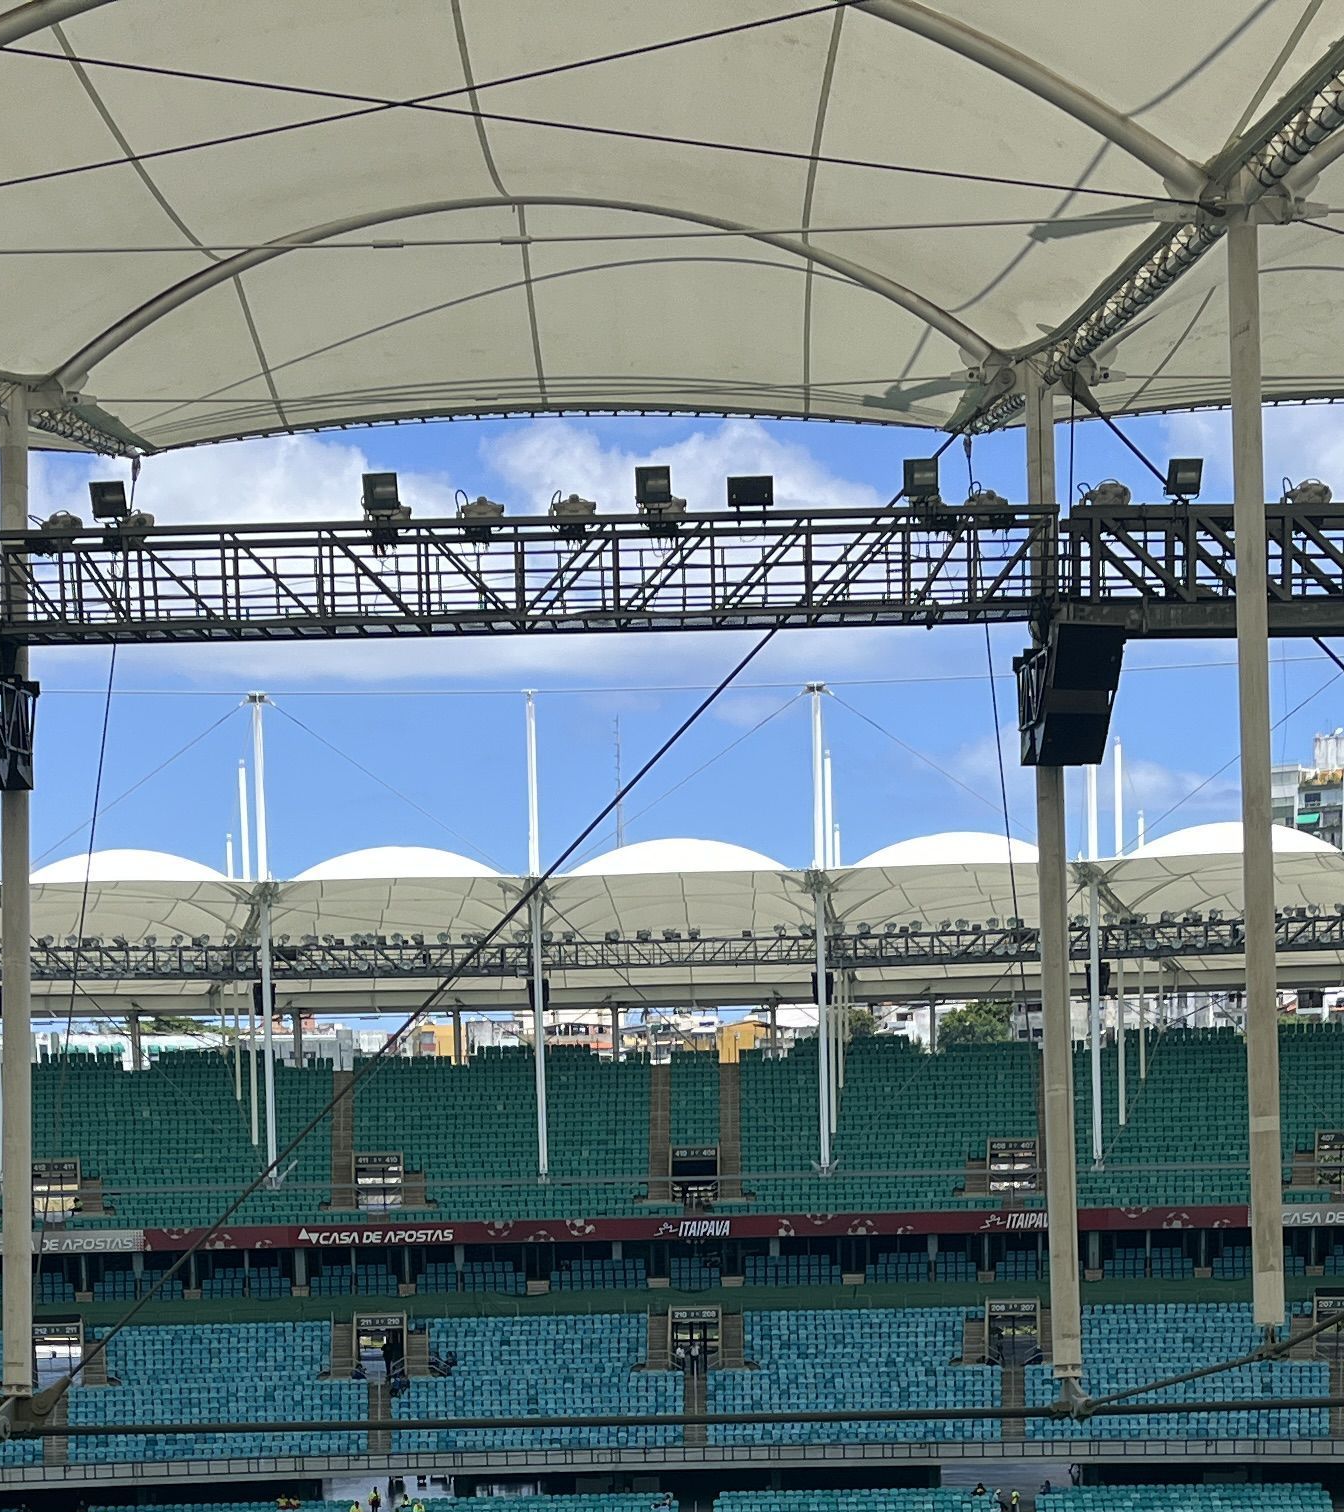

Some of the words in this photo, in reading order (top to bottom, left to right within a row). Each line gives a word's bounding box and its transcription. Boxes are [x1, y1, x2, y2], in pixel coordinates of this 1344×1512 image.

[1006, 1213, 1049, 1229] ITAIPAV
[1281, 1212, 1321, 1224] CASA
[678, 1220, 730, 1237] ITAIPAVA
[319, 1232, 359, 1244] CASA
[362, 1231, 383, 1243] DE
[384, 1229, 454, 1243] APOSTAS
[61, 1238, 134, 1251] APOSTAS
